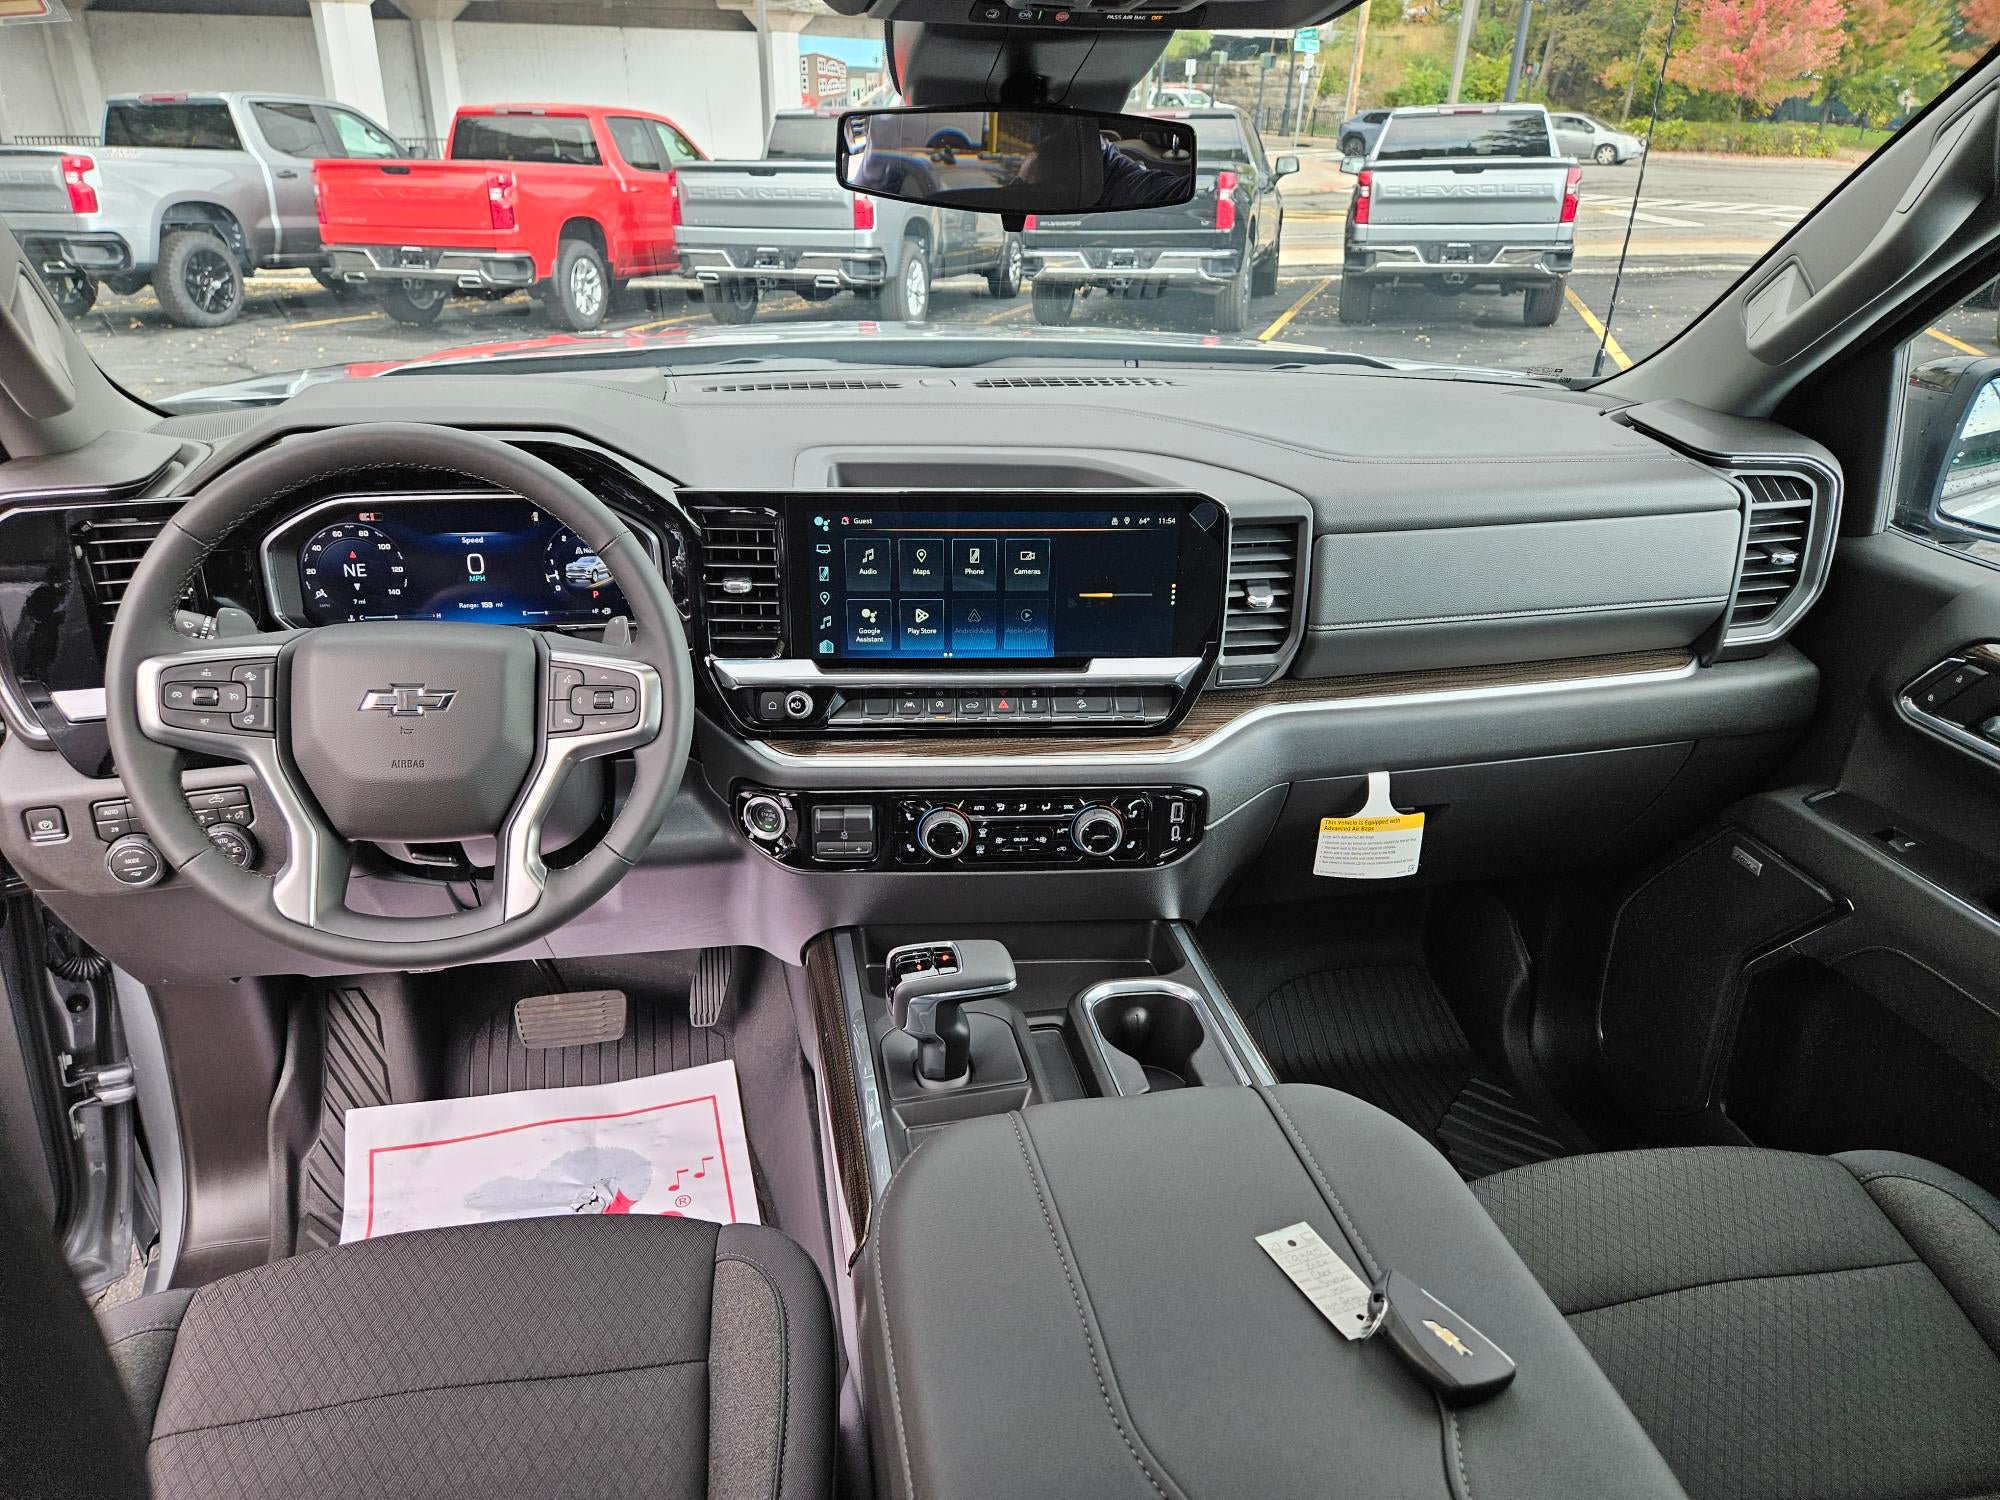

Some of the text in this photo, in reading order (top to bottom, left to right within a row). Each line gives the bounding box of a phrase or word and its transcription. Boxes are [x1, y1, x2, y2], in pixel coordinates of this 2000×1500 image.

[686, 185, 842, 200] CHEVROLET
[1383, 183, 1553, 198] CHEVROLET
[853, 517, 873, 525] Guest
[1158, 517, 1176, 525] 11:54
[332, 530, 343, 538] 60
[461, 536, 484, 545] Speed
[311, 544, 322, 552] 40
[377, 543, 391, 551] 100
[466, 553, 485, 575] 0
[343, 563, 368, 578] NE
[859, 567, 878, 575] Audio
[912, 568, 931, 576] Maps
[964, 567, 985, 575] Phone
[1013, 567, 1041, 575] Cameras
[592, 590, 600, 598] P
[458, 602, 479, 610] Range:
[858, 627, 881, 636] Google
[907, 627, 937, 636] Play Store
[391, 759, 425, 768] AIRBAG
[103, 808, 118, 816] AUTO
[1364, 818, 1389, 826] Equipped
[125, 857, 140, 865] MODE
